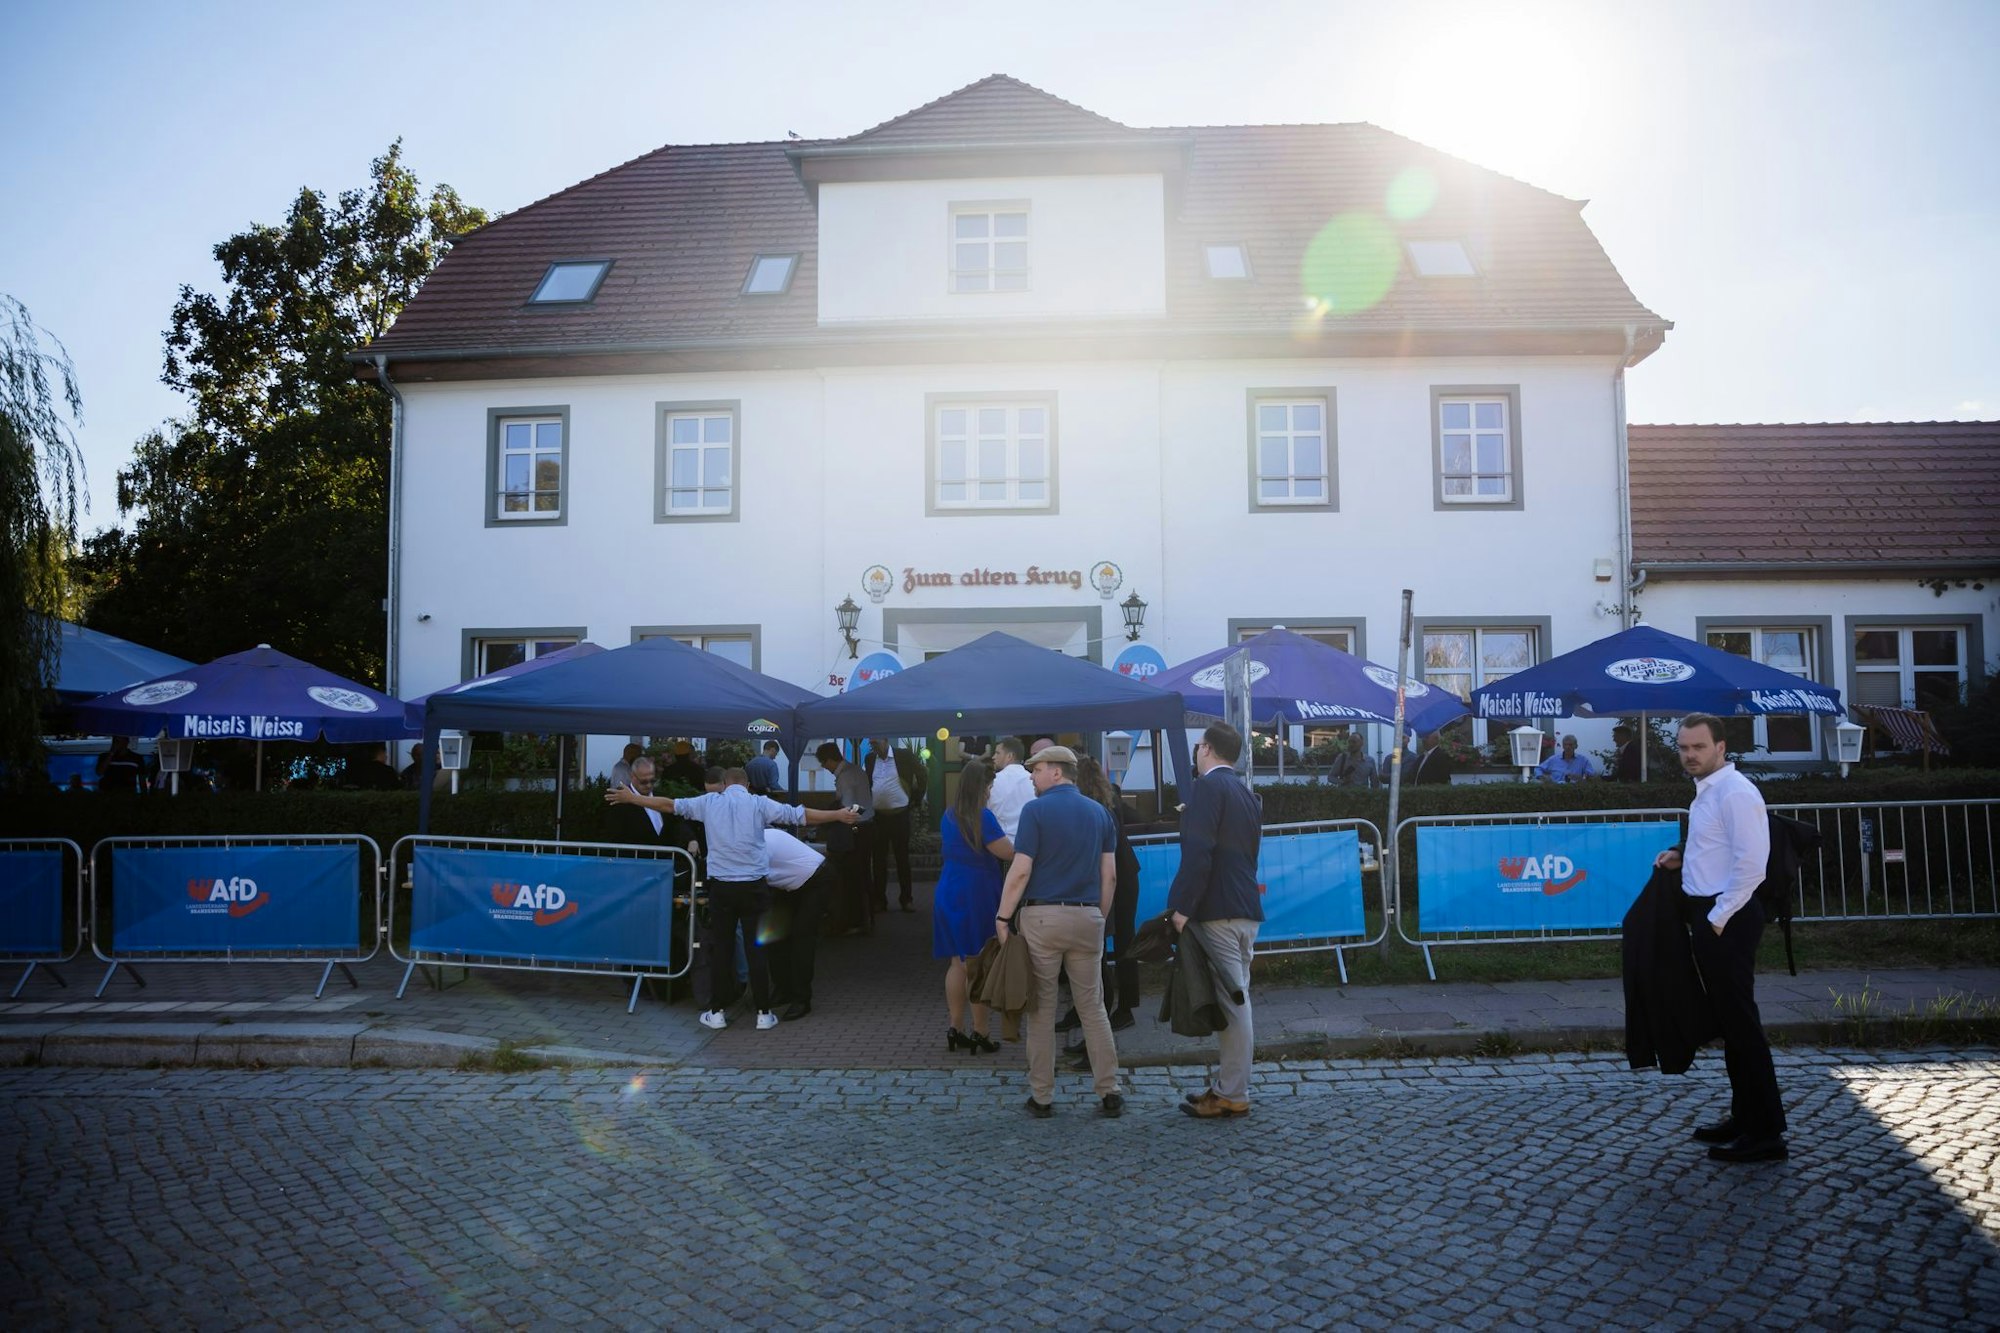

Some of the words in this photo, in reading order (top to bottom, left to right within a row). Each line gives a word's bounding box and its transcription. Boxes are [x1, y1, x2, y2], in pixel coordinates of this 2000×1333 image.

[903, 567, 953, 593] Zum
[960, 567, 1018, 586] alten
[1025, 565, 1082, 590] Krug
[1130, 662, 1158, 676] AfD
[1479, 693, 1522, 717] Maisel's
[1524, 692, 1562, 717] Weisse
[184, 715, 245, 737] Maisel's
[250, 716, 303, 738] Weisse
[1521, 854, 1574, 880] AfD
[209, 876, 258, 901] AfD
[513, 883, 566, 910] AfD
